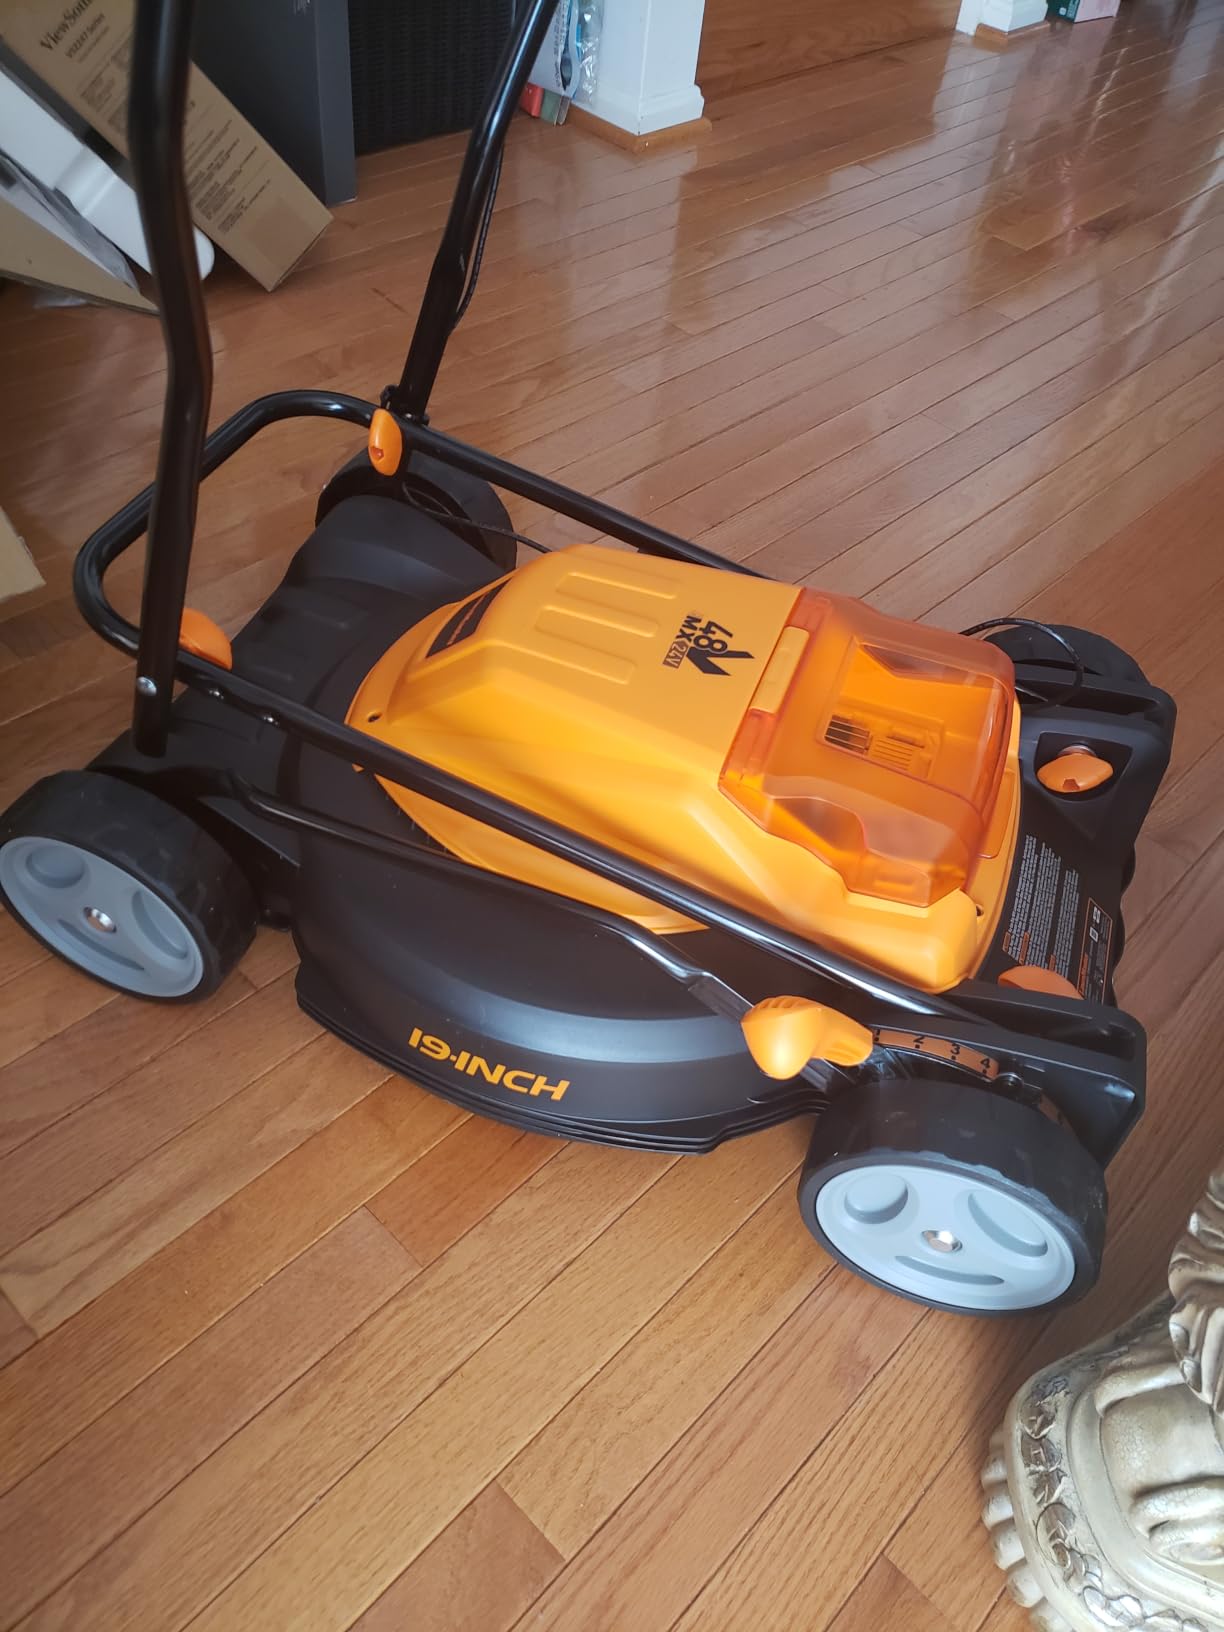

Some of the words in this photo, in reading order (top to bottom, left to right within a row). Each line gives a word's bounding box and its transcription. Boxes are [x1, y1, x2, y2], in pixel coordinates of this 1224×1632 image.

[40, 0, 92, 50] ViewSon
[676, 615, 702, 642] MX
[686, 620, 755, 676] 48V
[664, 642, 688, 667] 24V
[408, 1027, 571, 1101] 19-INCH
[913, 1035, 925, 1044] 2
[950, 1042, 960, 1055] 3
[980, 1057, 991, 1069] 4
